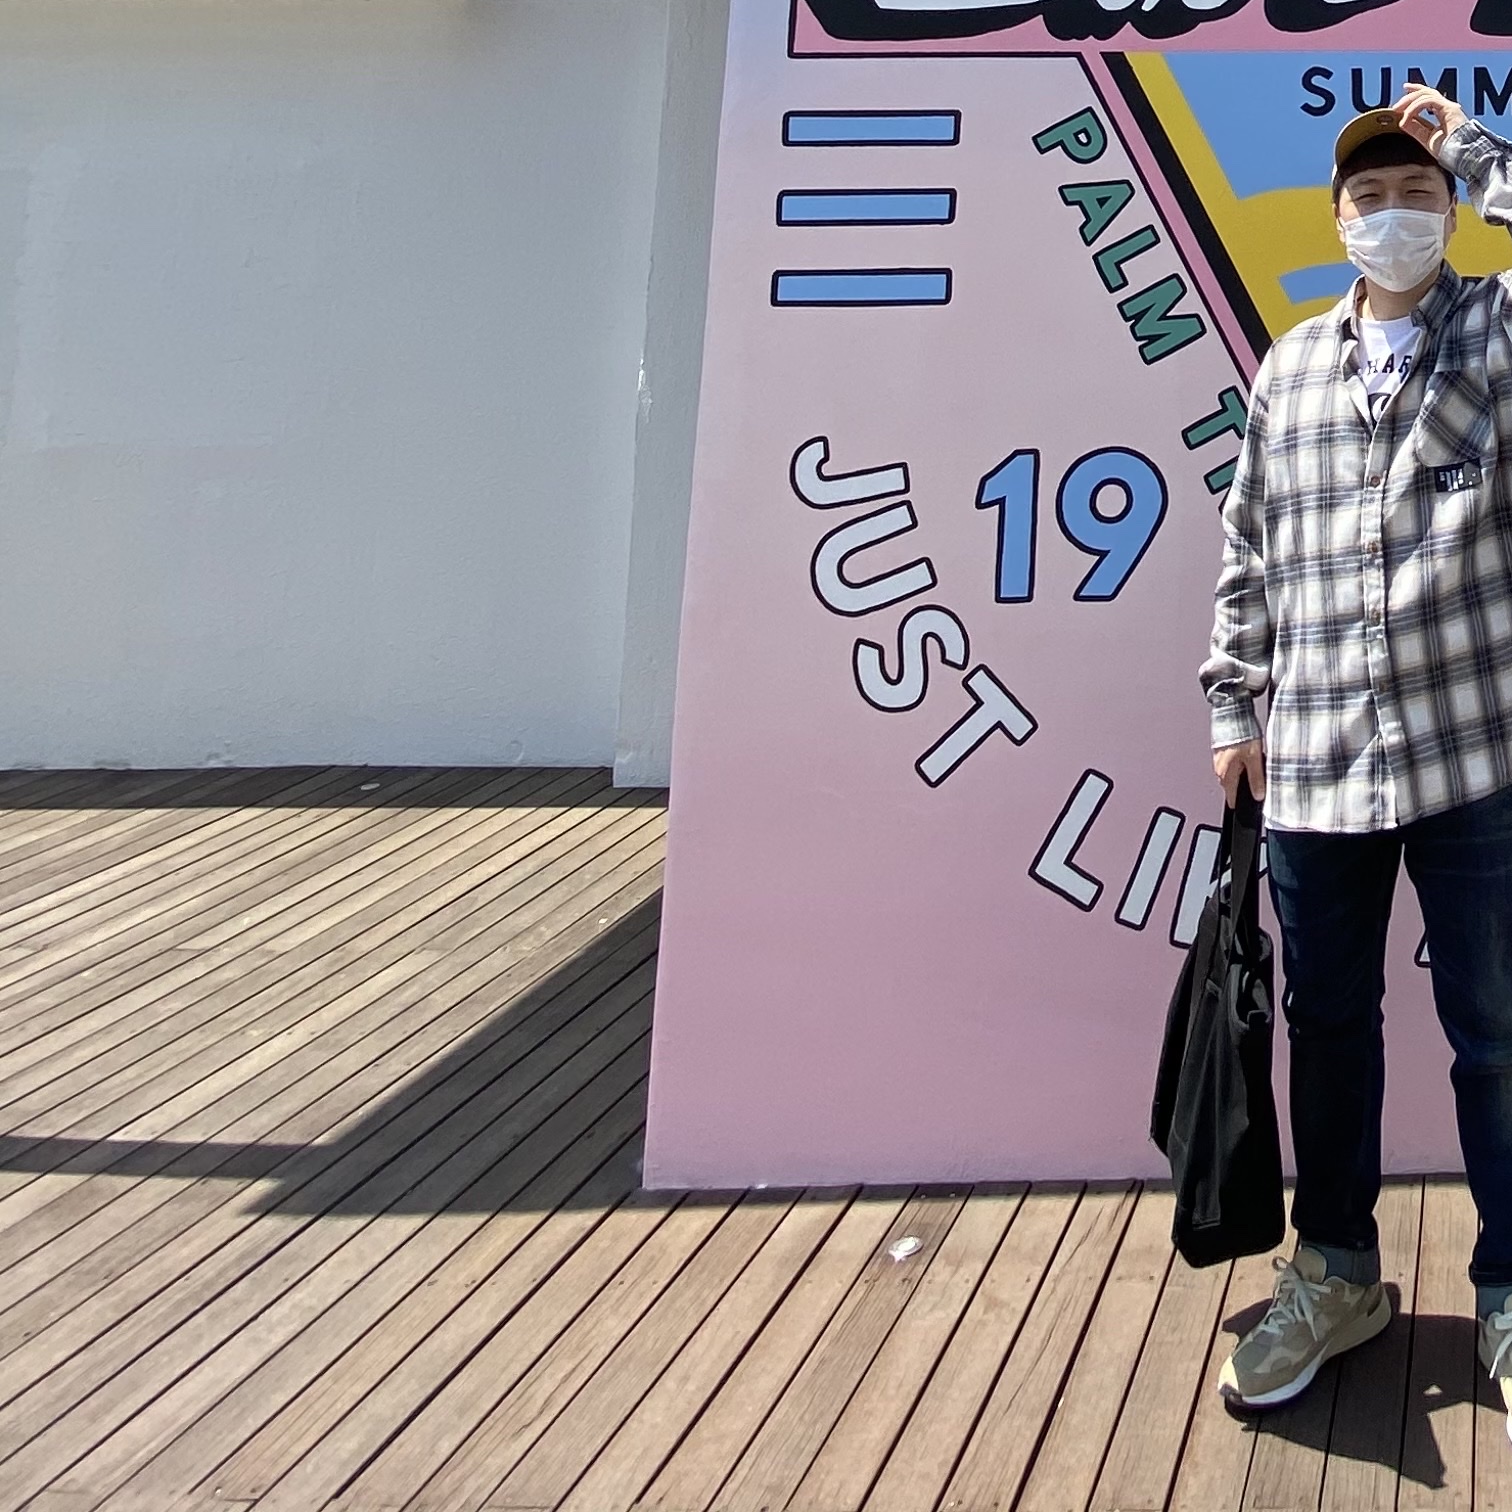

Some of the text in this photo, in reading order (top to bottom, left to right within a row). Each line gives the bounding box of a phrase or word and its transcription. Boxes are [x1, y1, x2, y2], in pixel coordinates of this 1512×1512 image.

[1032, 106, 1206, 365] PALM
[789, 436, 1038, 787] JUST
[975, 446, 1168, 603] 19
